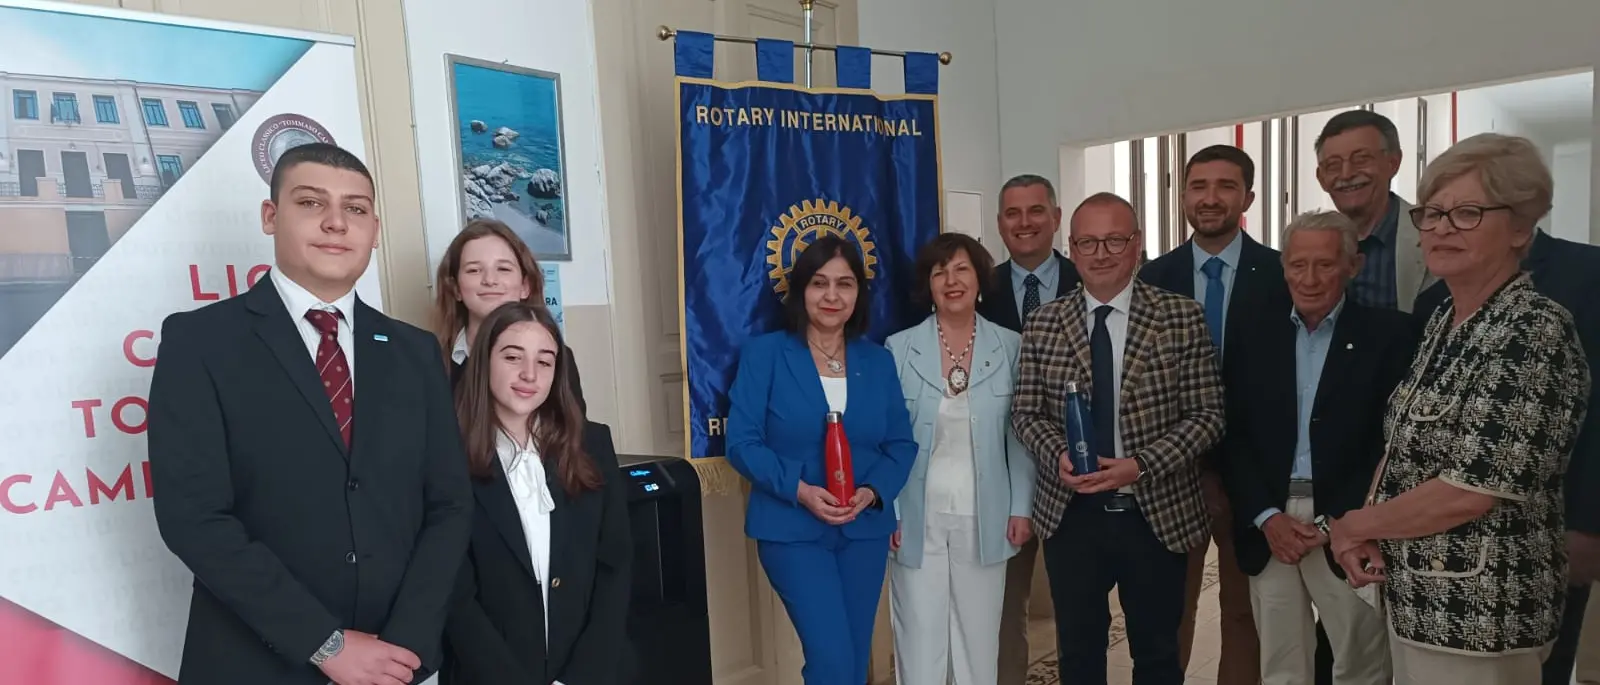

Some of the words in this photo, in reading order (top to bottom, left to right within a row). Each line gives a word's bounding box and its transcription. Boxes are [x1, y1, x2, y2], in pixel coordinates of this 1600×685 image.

[696, 105, 775, 126] ROTARY
[780, 111, 922, 137] INTERNATIONAL
[800, 214, 844, 231] ROTARY
[545, 297, 558, 306] RA
